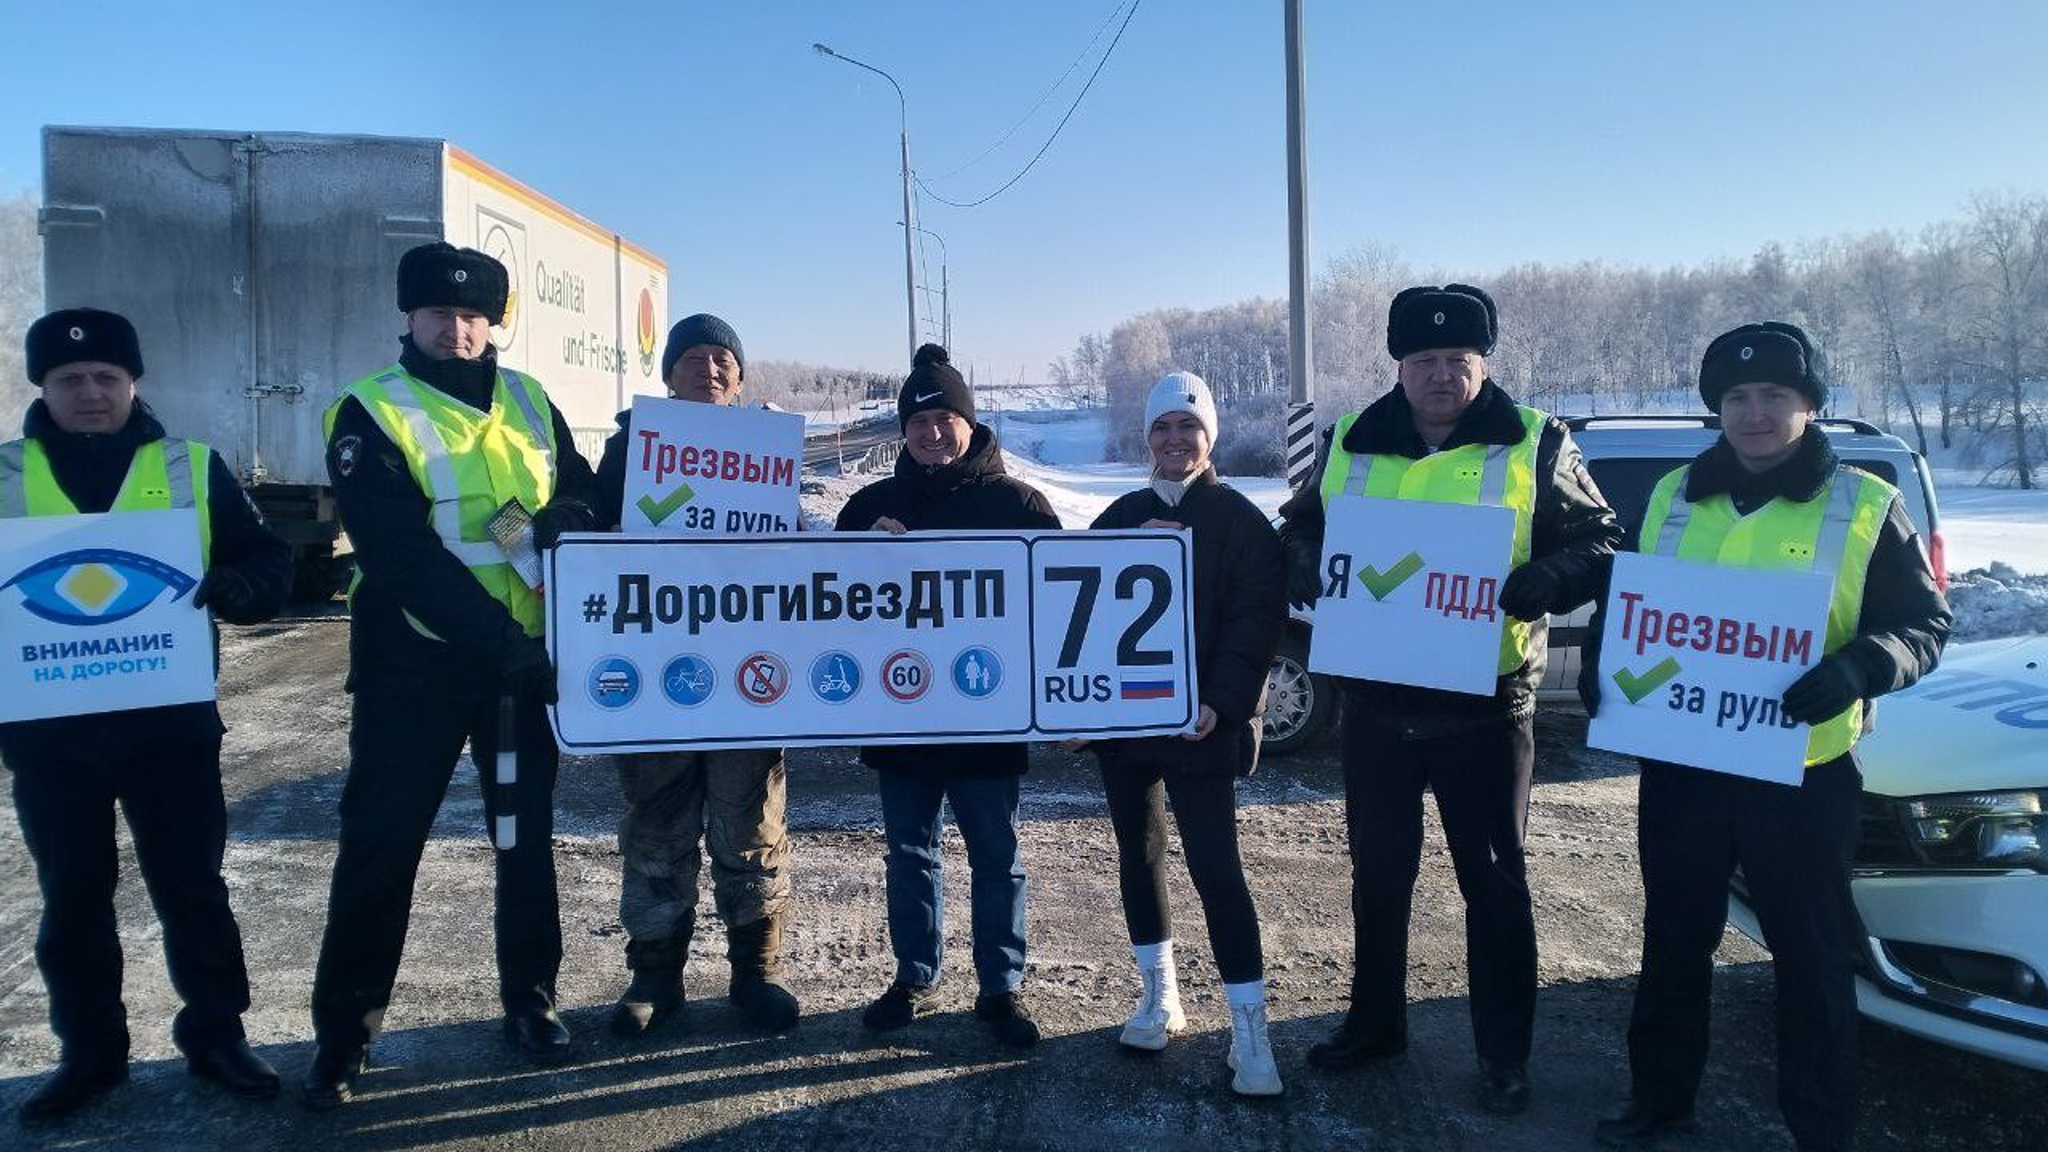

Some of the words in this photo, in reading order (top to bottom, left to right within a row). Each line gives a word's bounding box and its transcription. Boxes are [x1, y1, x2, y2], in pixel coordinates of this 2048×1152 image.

[535, 260, 586, 314] Qualität
[638, 430, 795, 487] Трезвым
[685, 506, 716, 530] за
[725, 509, 789, 533] руль
[583, 569, 1006, 635] #ДорогиБезДТП
[1325, 553, 1352, 599] Я
[1424, 571, 1498, 622] ПДД
[1044, 564, 1174, 669] 72
[1619, 591, 1813, 666] Трезвым
[22, 633, 174, 662] ВНИМАНИЕ
[34, 666, 66, 682] НА
[71, 656, 167, 681] ДОРОГУ!
[892, 665, 922, 687] 60
[1044, 674, 1113, 703] RUS
[1668, 683, 1705, 714] за
